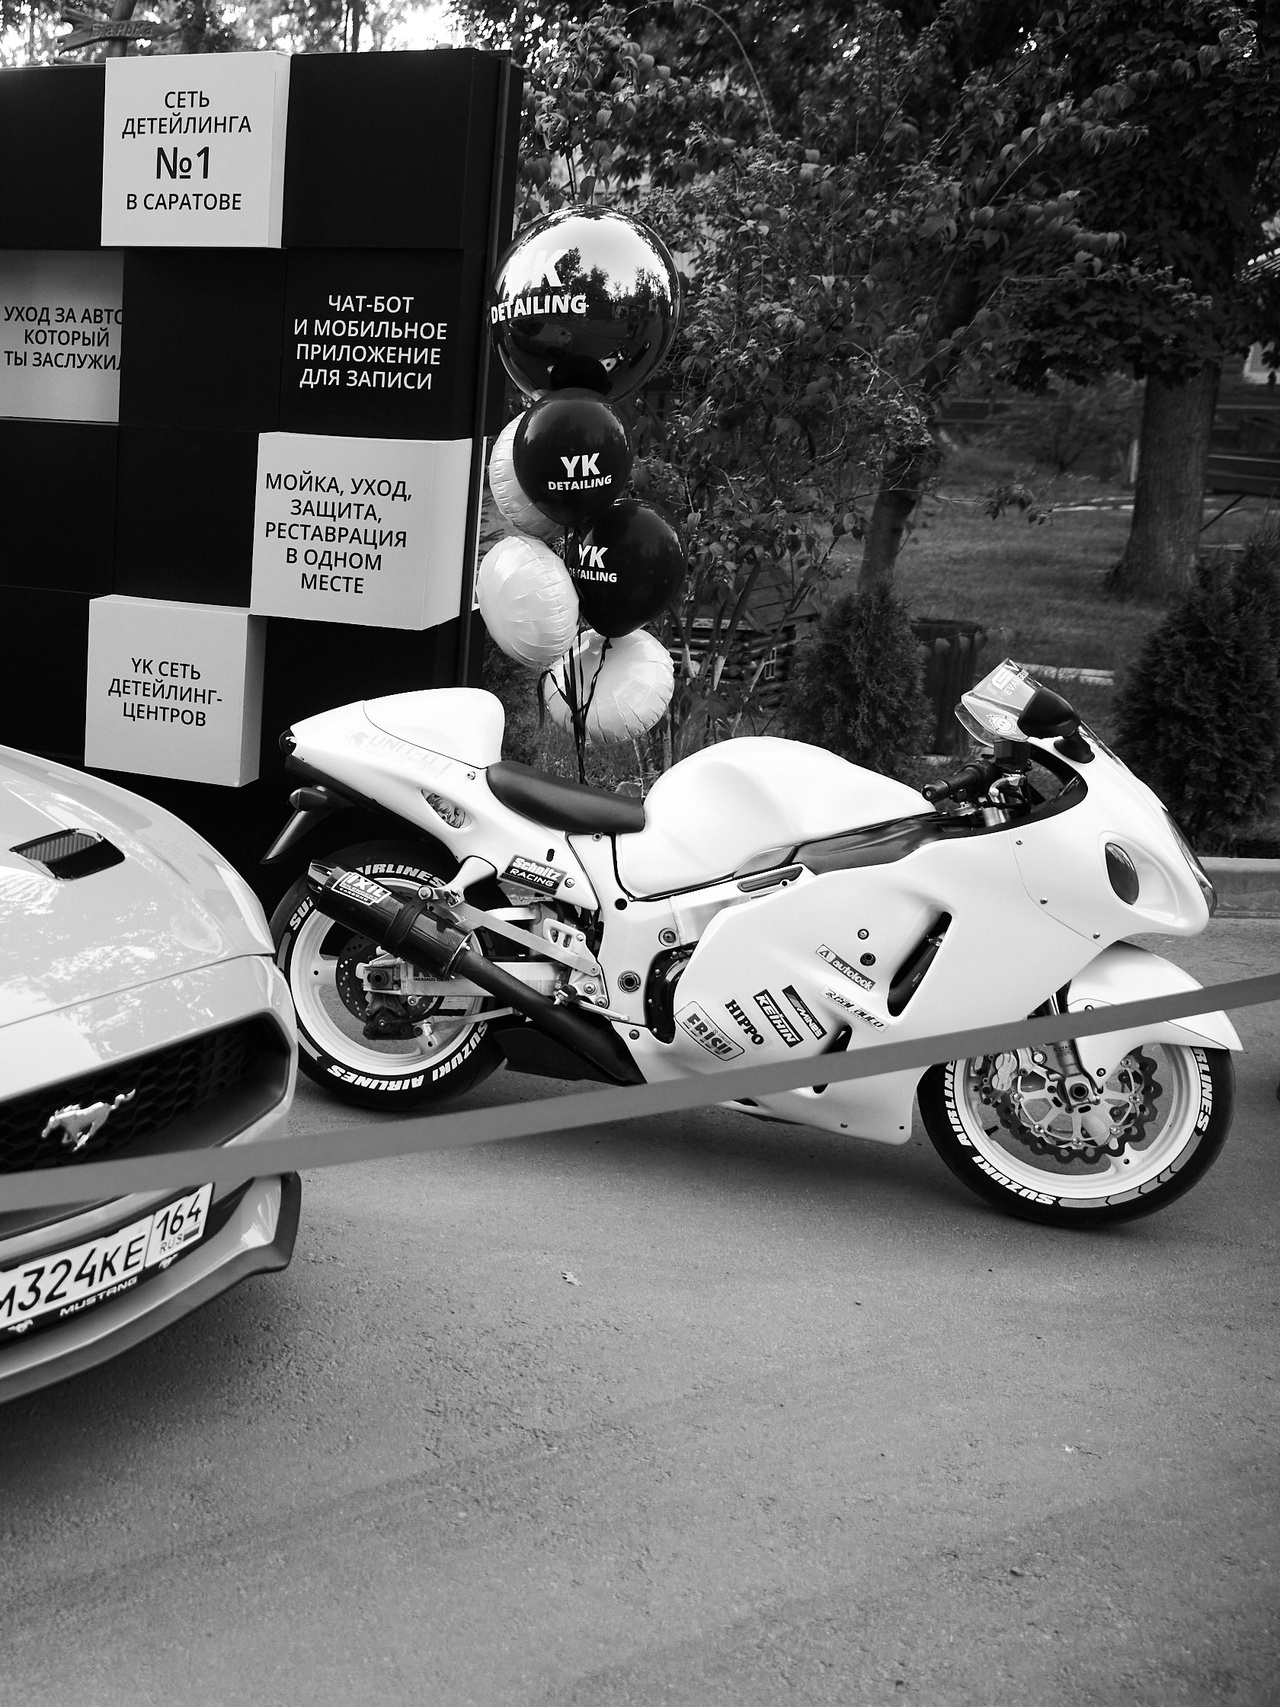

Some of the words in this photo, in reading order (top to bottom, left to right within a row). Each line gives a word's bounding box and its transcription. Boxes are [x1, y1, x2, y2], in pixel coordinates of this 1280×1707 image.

[164, 90, 210, 108] СЕТЬ
[122, 111, 252, 139] ДЕТЕЙЛИНГА
[156, 146, 210, 180] №1
[126, 193, 138, 210] В
[143, 193, 242, 211] САРАТОВЕ
[4, 305, 51, 326] УХОД
[54, 307, 77, 323] ЗА
[328, 294, 415, 314] ЧАТ-БОТ
[491, 294, 587, 324] DETAILING
[24, 327, 110, 348] КОТОРЫЙ
[294, 318, 308, 336] И
[314, 319, 448, 340] МОБИЛЬНОЕ
[4, 350, 28, 367] ТЫ
[296, 343, 441, 365] ПРИЛОЖЕНИЕ
[299, 368, 340, 389] ДЛЯ
[346, 369, 432, 390] ЗАПИСИ
[560, 453, 600, 477] YK
[265, 471, 345, 496] МОЙКА,
[350, 477, 412, 502] УХОД,
[548, 475, 612, 490] DETAILING
[290, 499, 382, 524] ЗАЩИТА,
[265, 522, 407, 548] РЕСТАВРАЦИЯ
[286, 547, 298, 564] В
[303, 549, 382, 572] ОДНОМ
[579, 544, 608, 568] YK
[301, 572, 365, 594] МЕСТЕ
[157, 660, 202, 681] СЕТЬ
[107, 678, 223, 706] ДЕТЕЙЛИНГ-
[122, 701, 207, 727] ЦЕНТРОВ
[347, 874, 384, 898] IXIL
[509, 868, 555, 887] RACING
[832, 960, 873, 991] autolook
[724, 998, 765, 1045] HIPPO
[755, 993, 800, 1043] KEIHIN
[431, 1021, 488, 1082] SUZUKI
[326, 1064, 424, 1091] AIRLINES
[1192, 1047, 1213, 1132] RLINES
[972, 1155, 1057, 1205] SUZUKI
[155, 1193, 202, 1242] 164
[159, 1233, 184, 1254] RUS
[59, 1275, 138, 1317] MUSTANG
